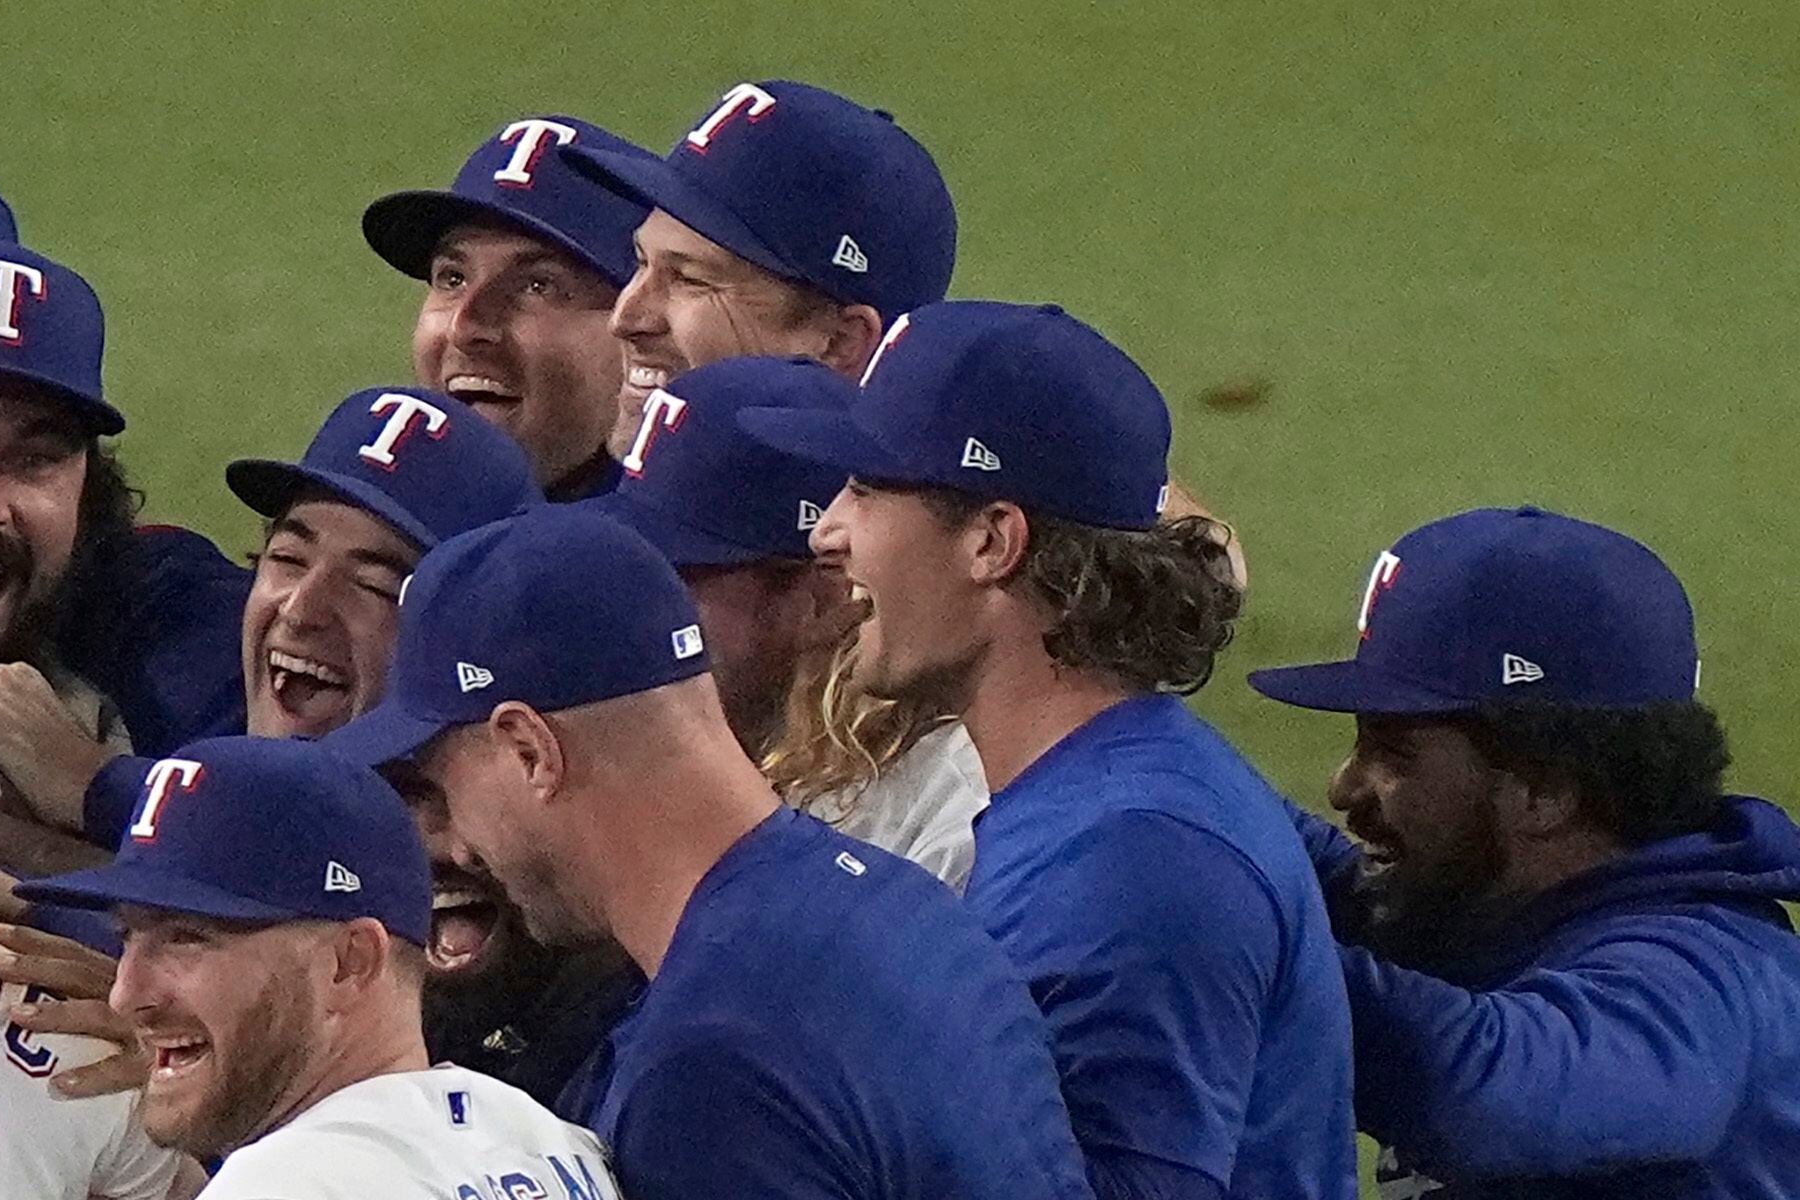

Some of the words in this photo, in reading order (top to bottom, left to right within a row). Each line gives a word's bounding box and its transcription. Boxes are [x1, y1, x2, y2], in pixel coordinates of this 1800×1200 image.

[493, 119, 578, 190] T
[686, 81, 777, 155] T
[358, 392, 450, 473] T
[622, 387, 689, 480] T
[130, 758, 205, 845] T
